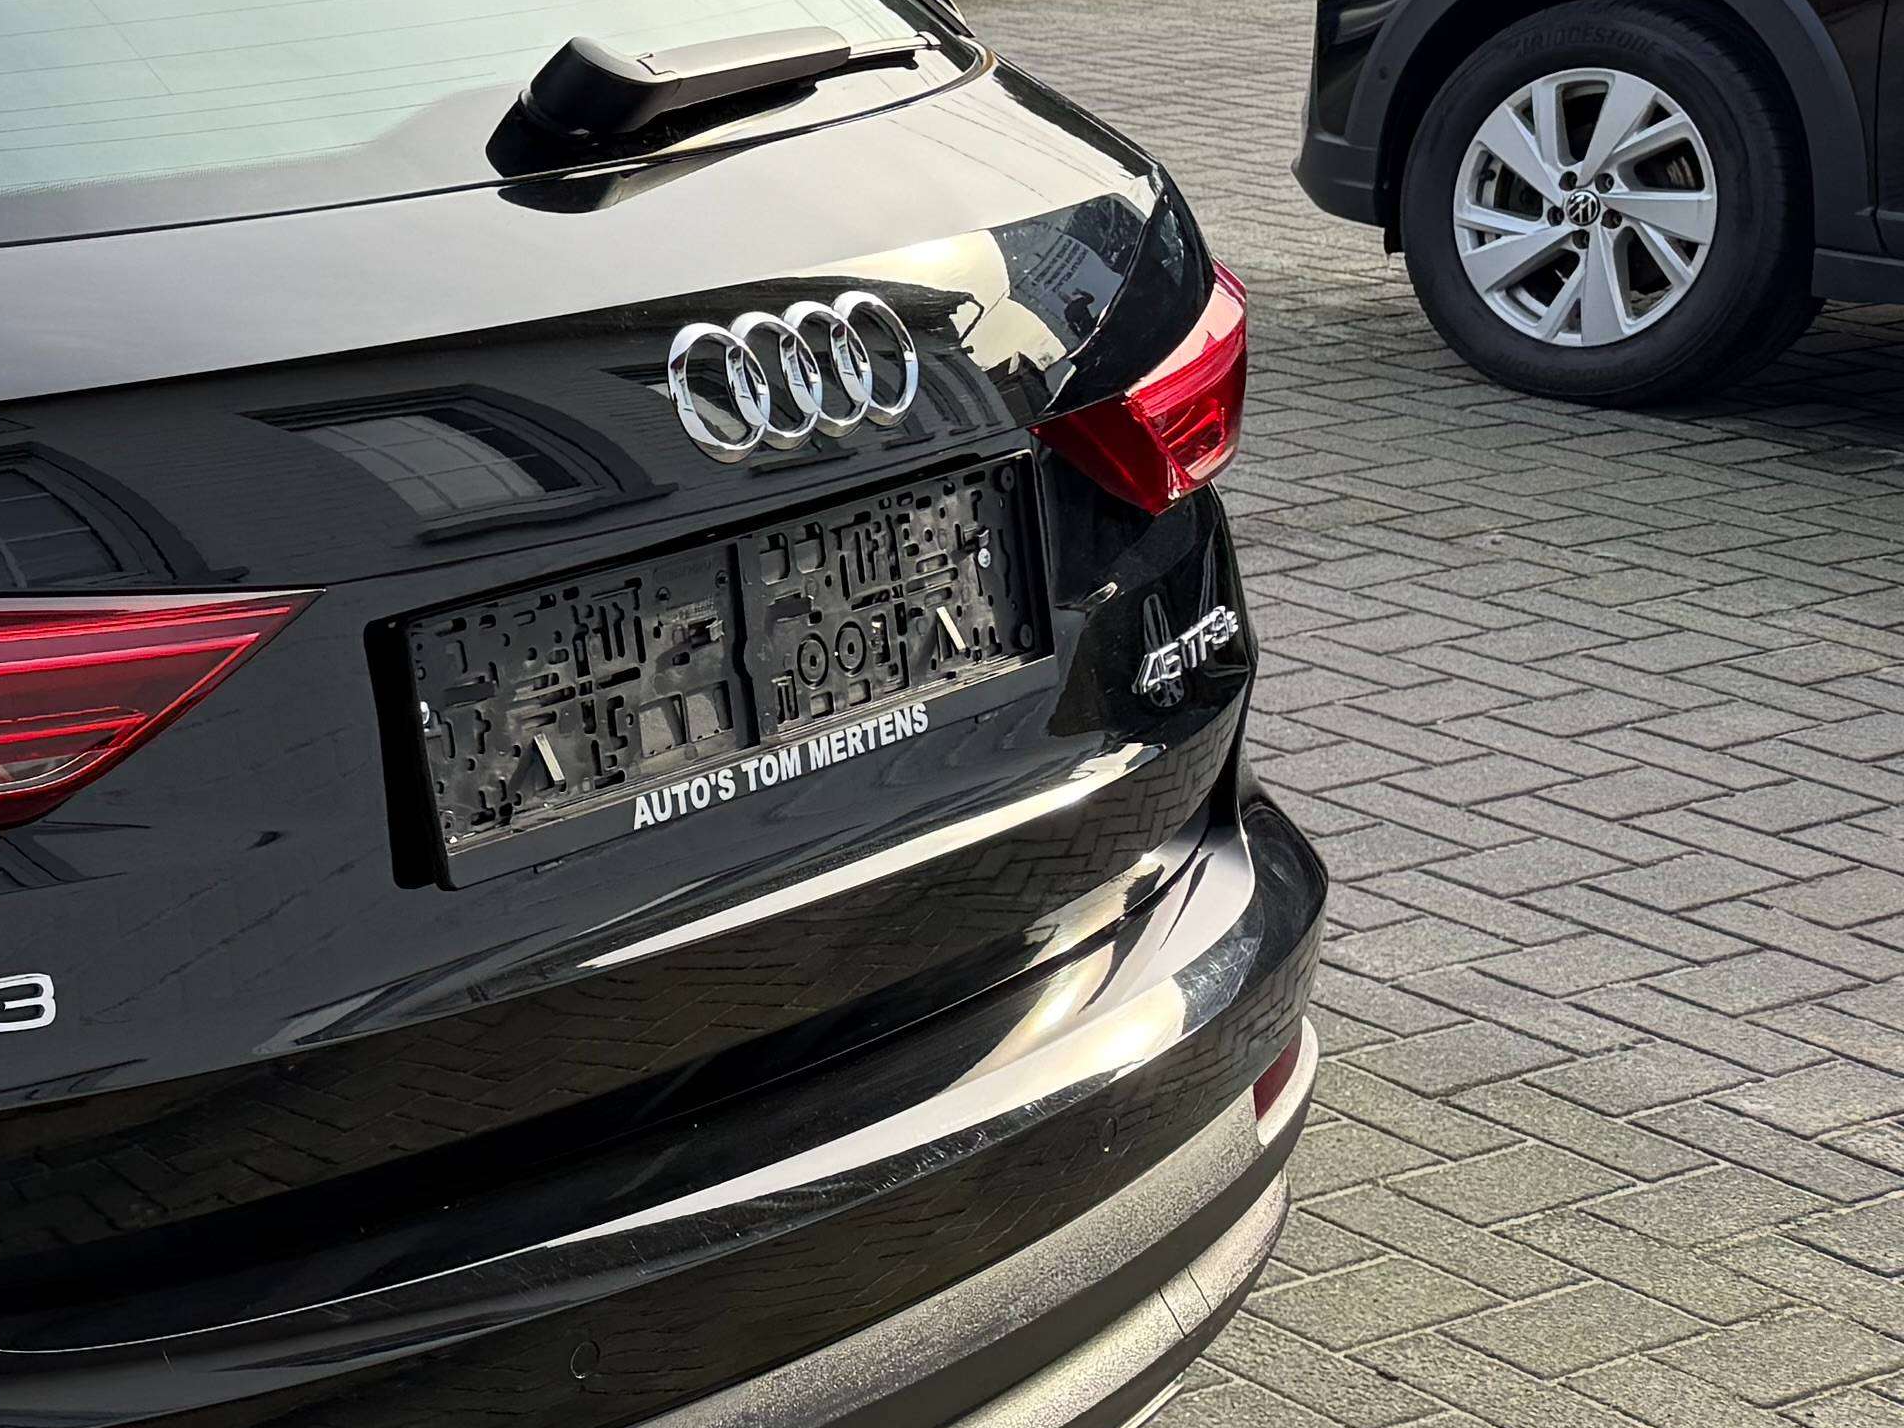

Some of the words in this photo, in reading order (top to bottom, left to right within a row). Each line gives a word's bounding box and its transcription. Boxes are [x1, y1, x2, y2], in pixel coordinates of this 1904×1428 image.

[633, 768, 737, 831] AUTO'S
[741, 746, 803, 793] TOM
[807, 702, 930, 771] MERTENS
